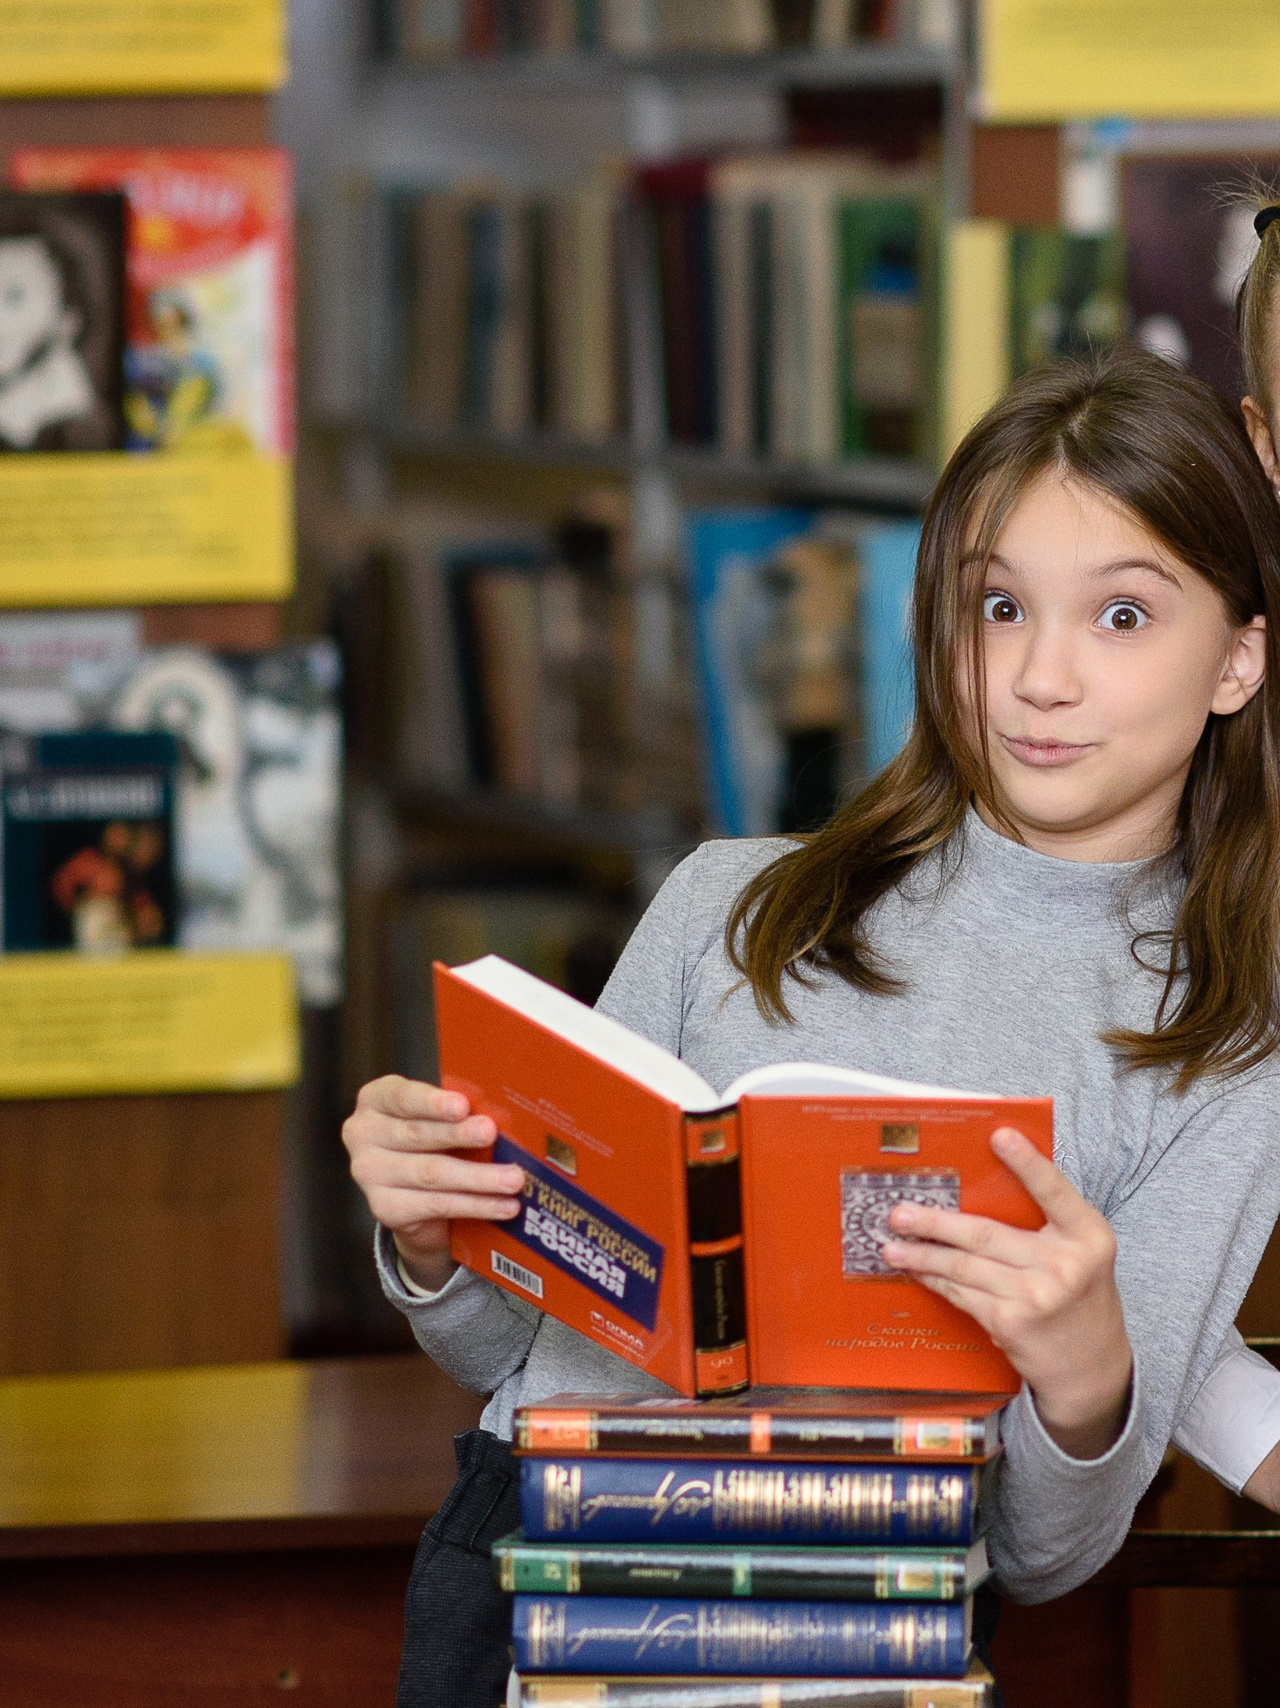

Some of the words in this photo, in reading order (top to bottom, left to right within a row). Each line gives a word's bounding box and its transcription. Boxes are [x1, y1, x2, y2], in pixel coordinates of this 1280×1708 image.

[523, 1219, 626, 1299] РОССИЯ
[525, 1205, 628, 1285] ЕДИНАЯ
[537, 1186, 585, 1229] КНИГ
[586, 1222, 658, 1284] РОССИИ
[825, 1336, 905, 1352] народов
[866, 1322, 941, 1338] Сказки
